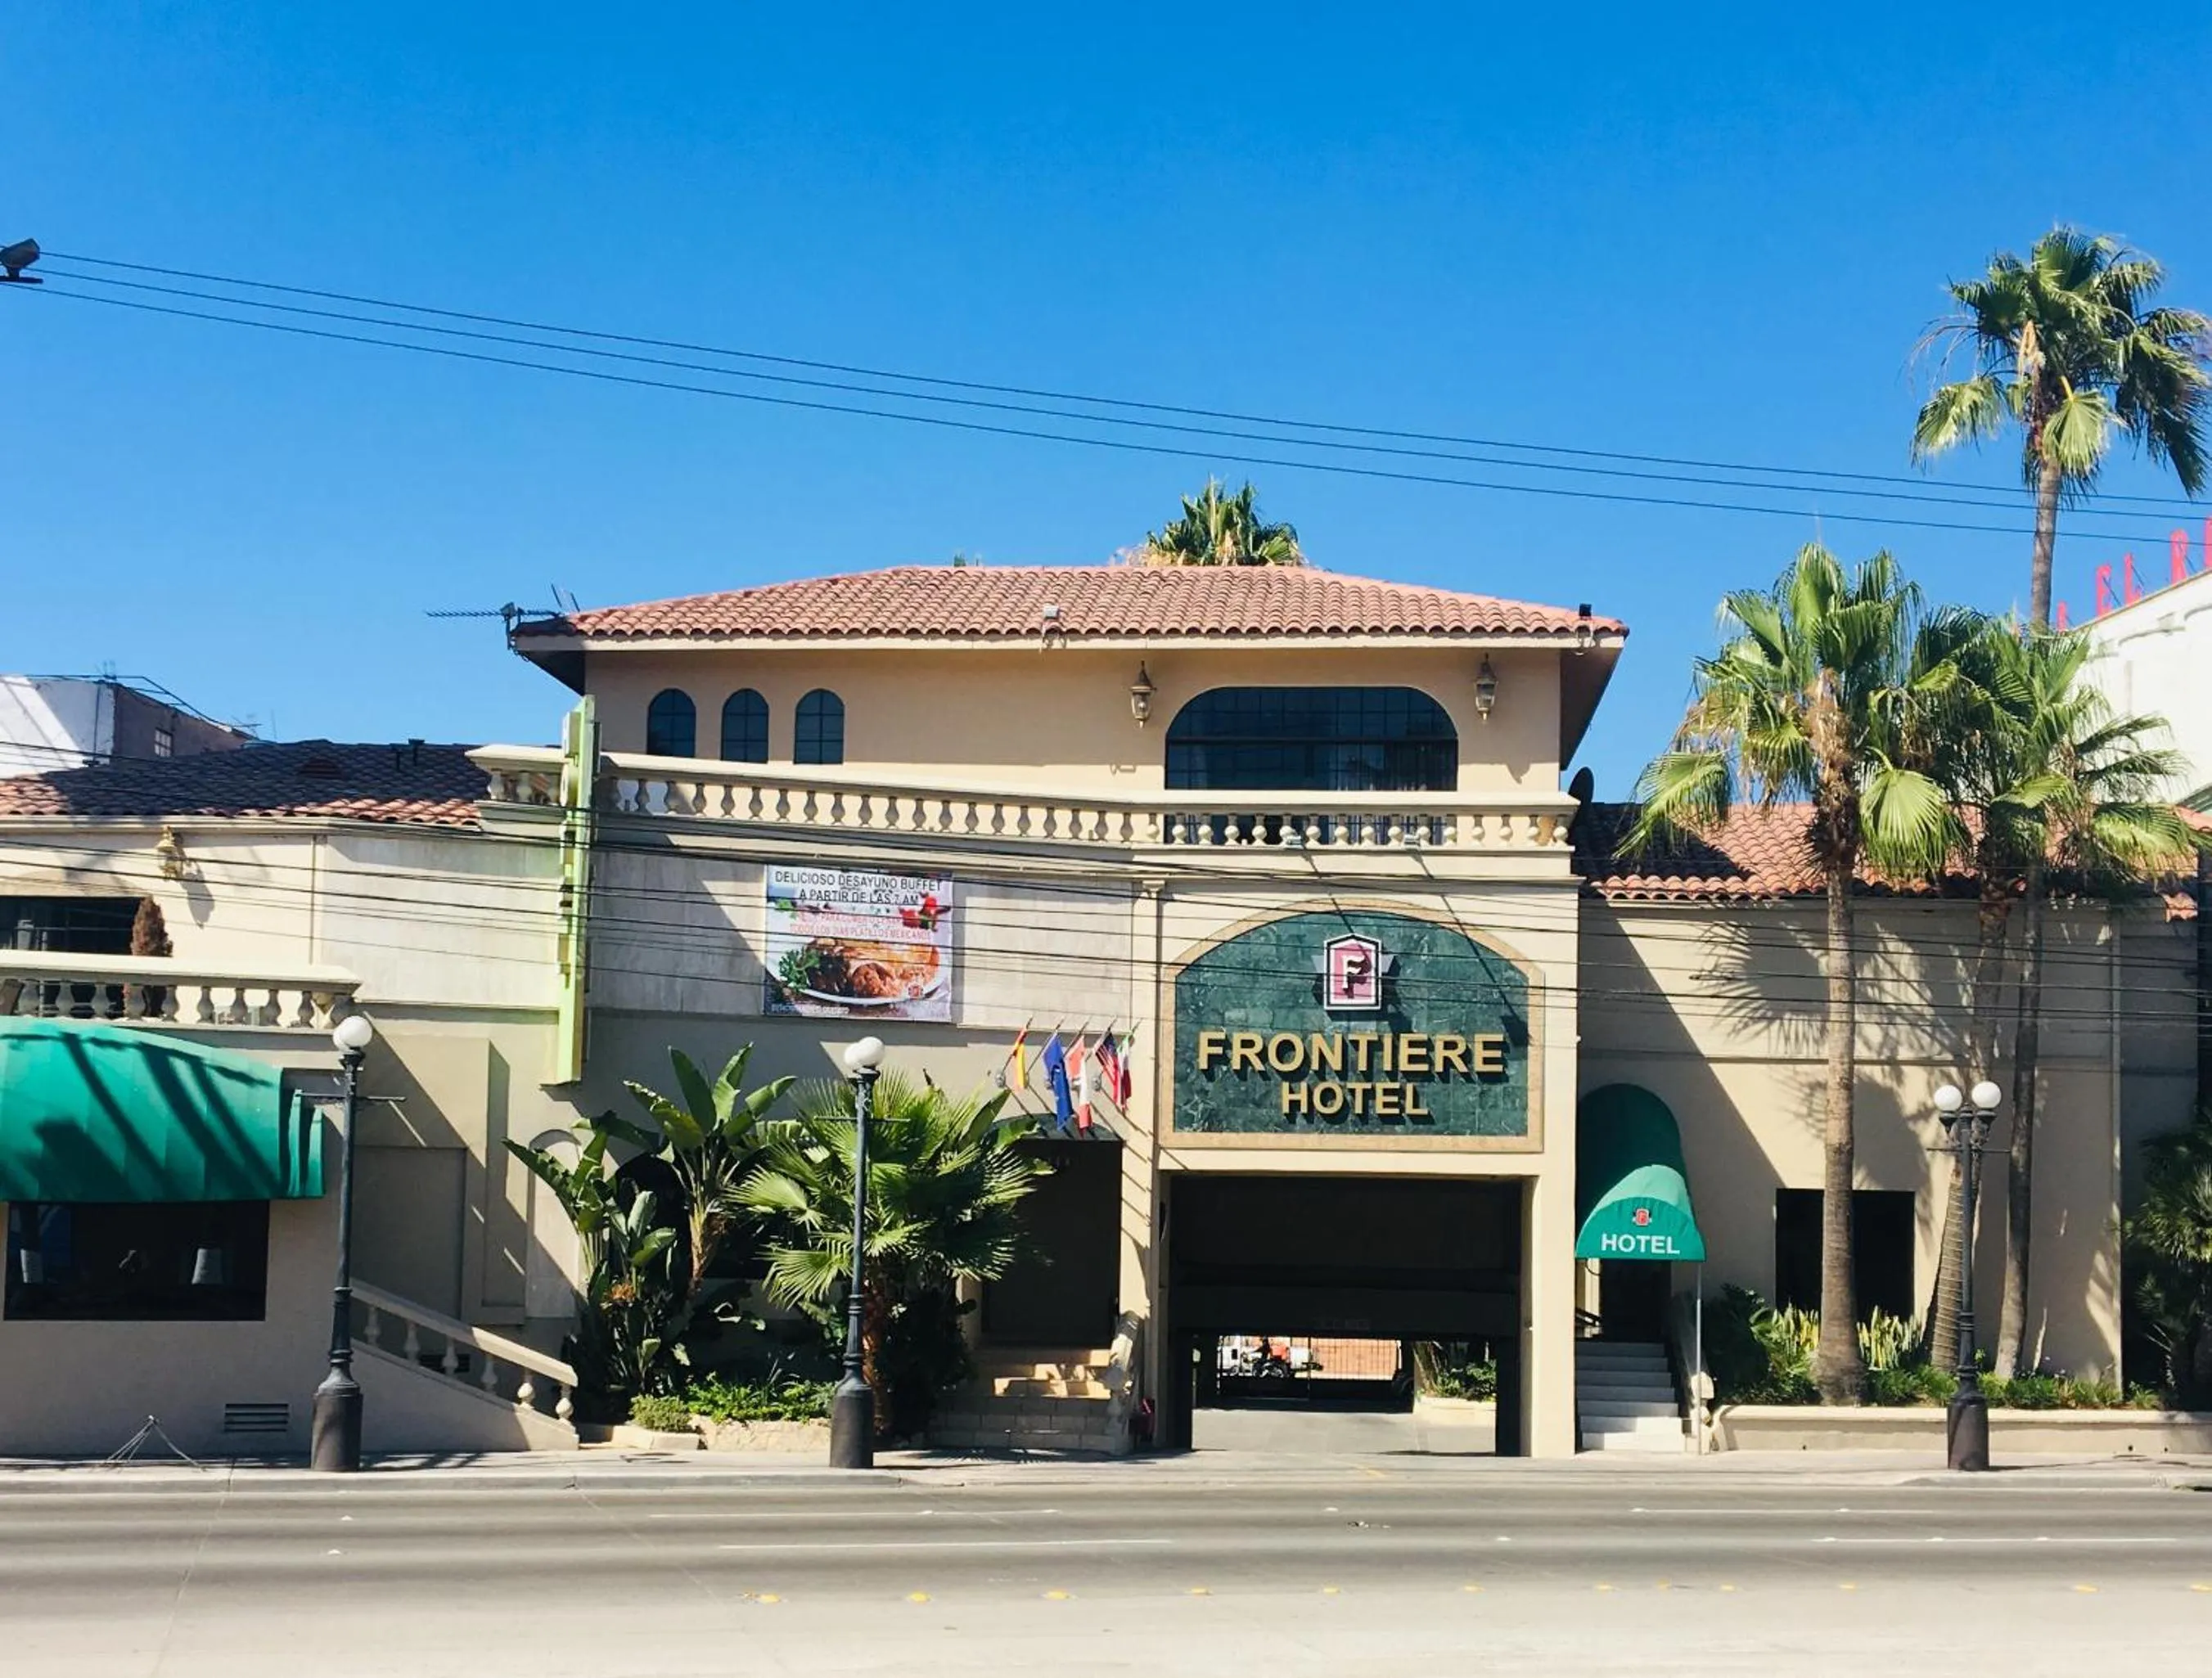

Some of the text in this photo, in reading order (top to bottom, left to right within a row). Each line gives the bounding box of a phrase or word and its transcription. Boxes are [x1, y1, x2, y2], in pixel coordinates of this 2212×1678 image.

[775, 870, 941, 892] DELICIOSO DESAYUNO BUFFET
[800, 889, 806, 899] A
[809, 890, 849, 902] PARTIR
[852, 892, 866, 902] DE
[869, 893, 890, 904] LAS
[903, 894, 919, 905] AM
[1198, 1031, 1506, 1073] FRONTIERE
[1281, 1082, 1429, 1116] HOTEL
[1601, 1233, 1680, 1255] HOTEL
